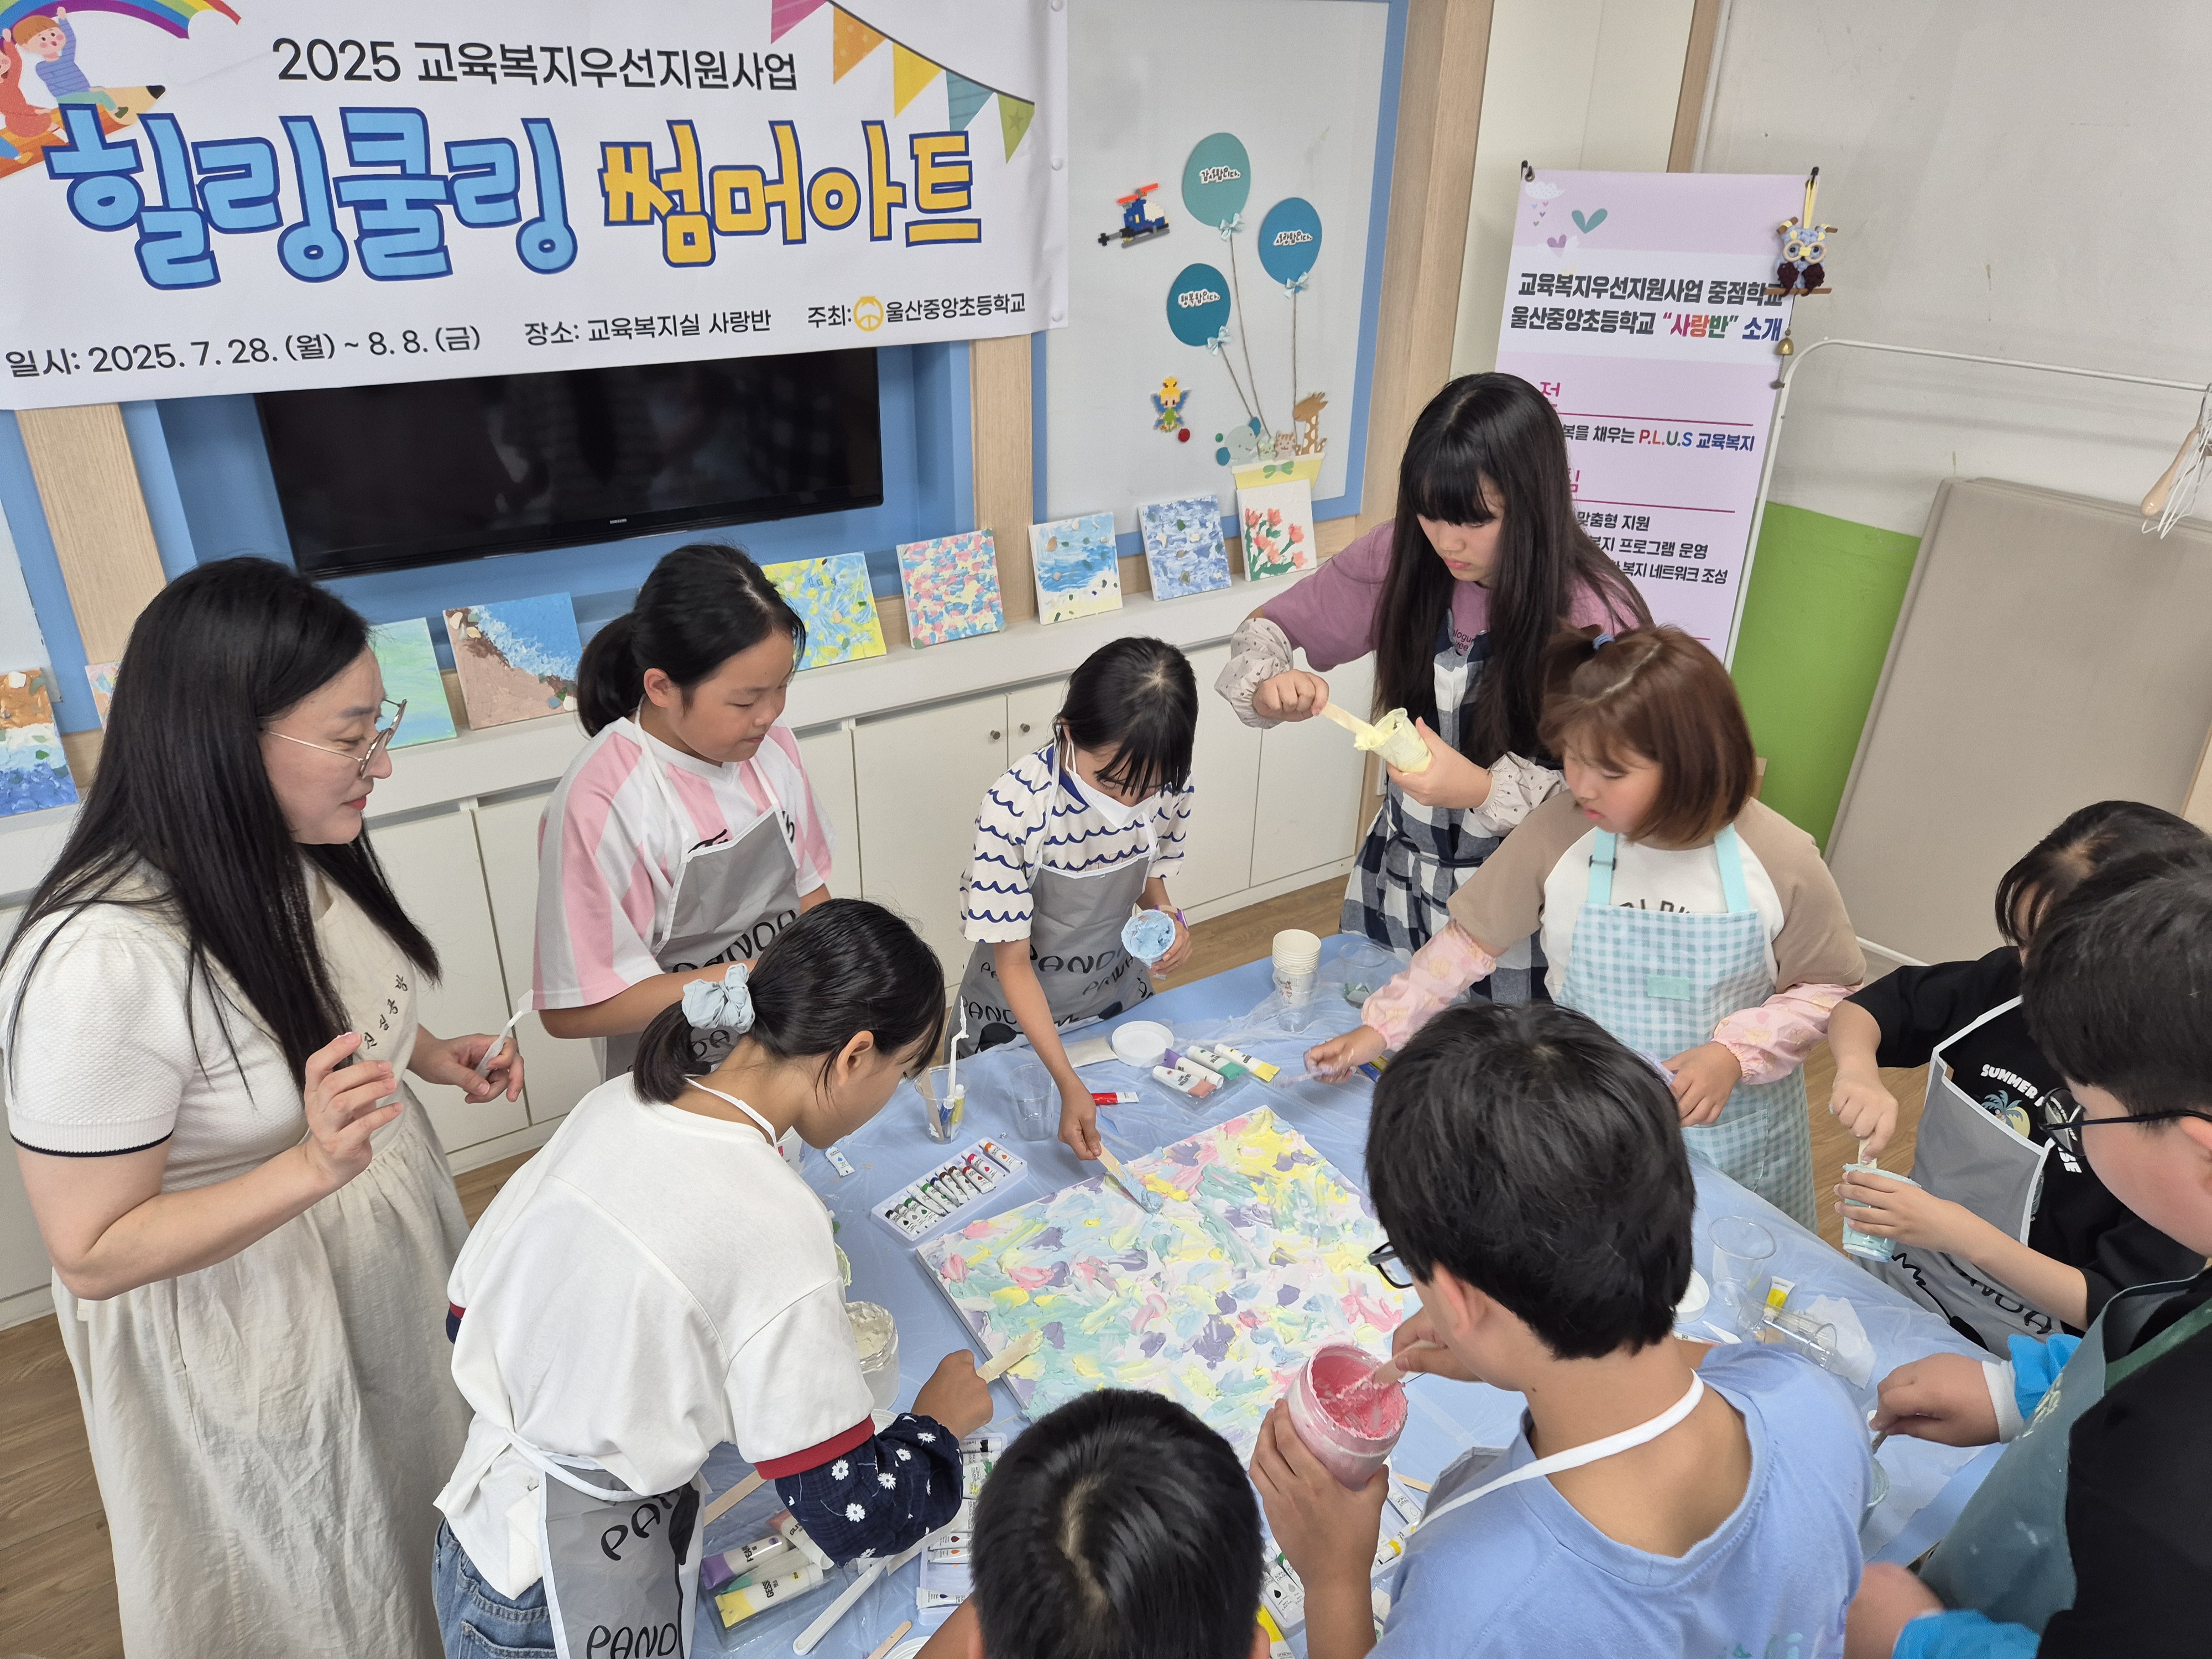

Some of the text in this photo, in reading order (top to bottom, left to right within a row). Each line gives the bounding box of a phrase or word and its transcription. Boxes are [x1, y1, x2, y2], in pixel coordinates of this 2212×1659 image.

[272, 37, 797, 91] 2025 교육복지우선지원사업
[43, 103, 982, 290] 힐링쿨링 썸머아트
[1518, 273, 1702, 303] 교육복지우선지원사업
[524, 309, 771, 346] 장소: 교육복지실 사랑반
[807, 293, 1026, 329] 주최: 울산중앙초등학교
[1510, 306, 1656, 335] 울산중앙초등학교
[1742, 317, 1783, 342] 소개
[5, 347, 81, 378] 일시:
[1592, 425, 1635, 445] 채우는
[1639, 429, 1693, 447] P.L.U.S
[1695, 432, 1756, 452] 교육복지
[1621, 515, 1651, 533] 지원
[1618, 538, 1676, 558] 프로그램
[1678, 543, 1709, 560] 운영
[1649, 564, 1700, 583] 네트워크
[1701, 568, 1729, 585] 조성
[1980, 1063, 2038, 1099] SUMMER
